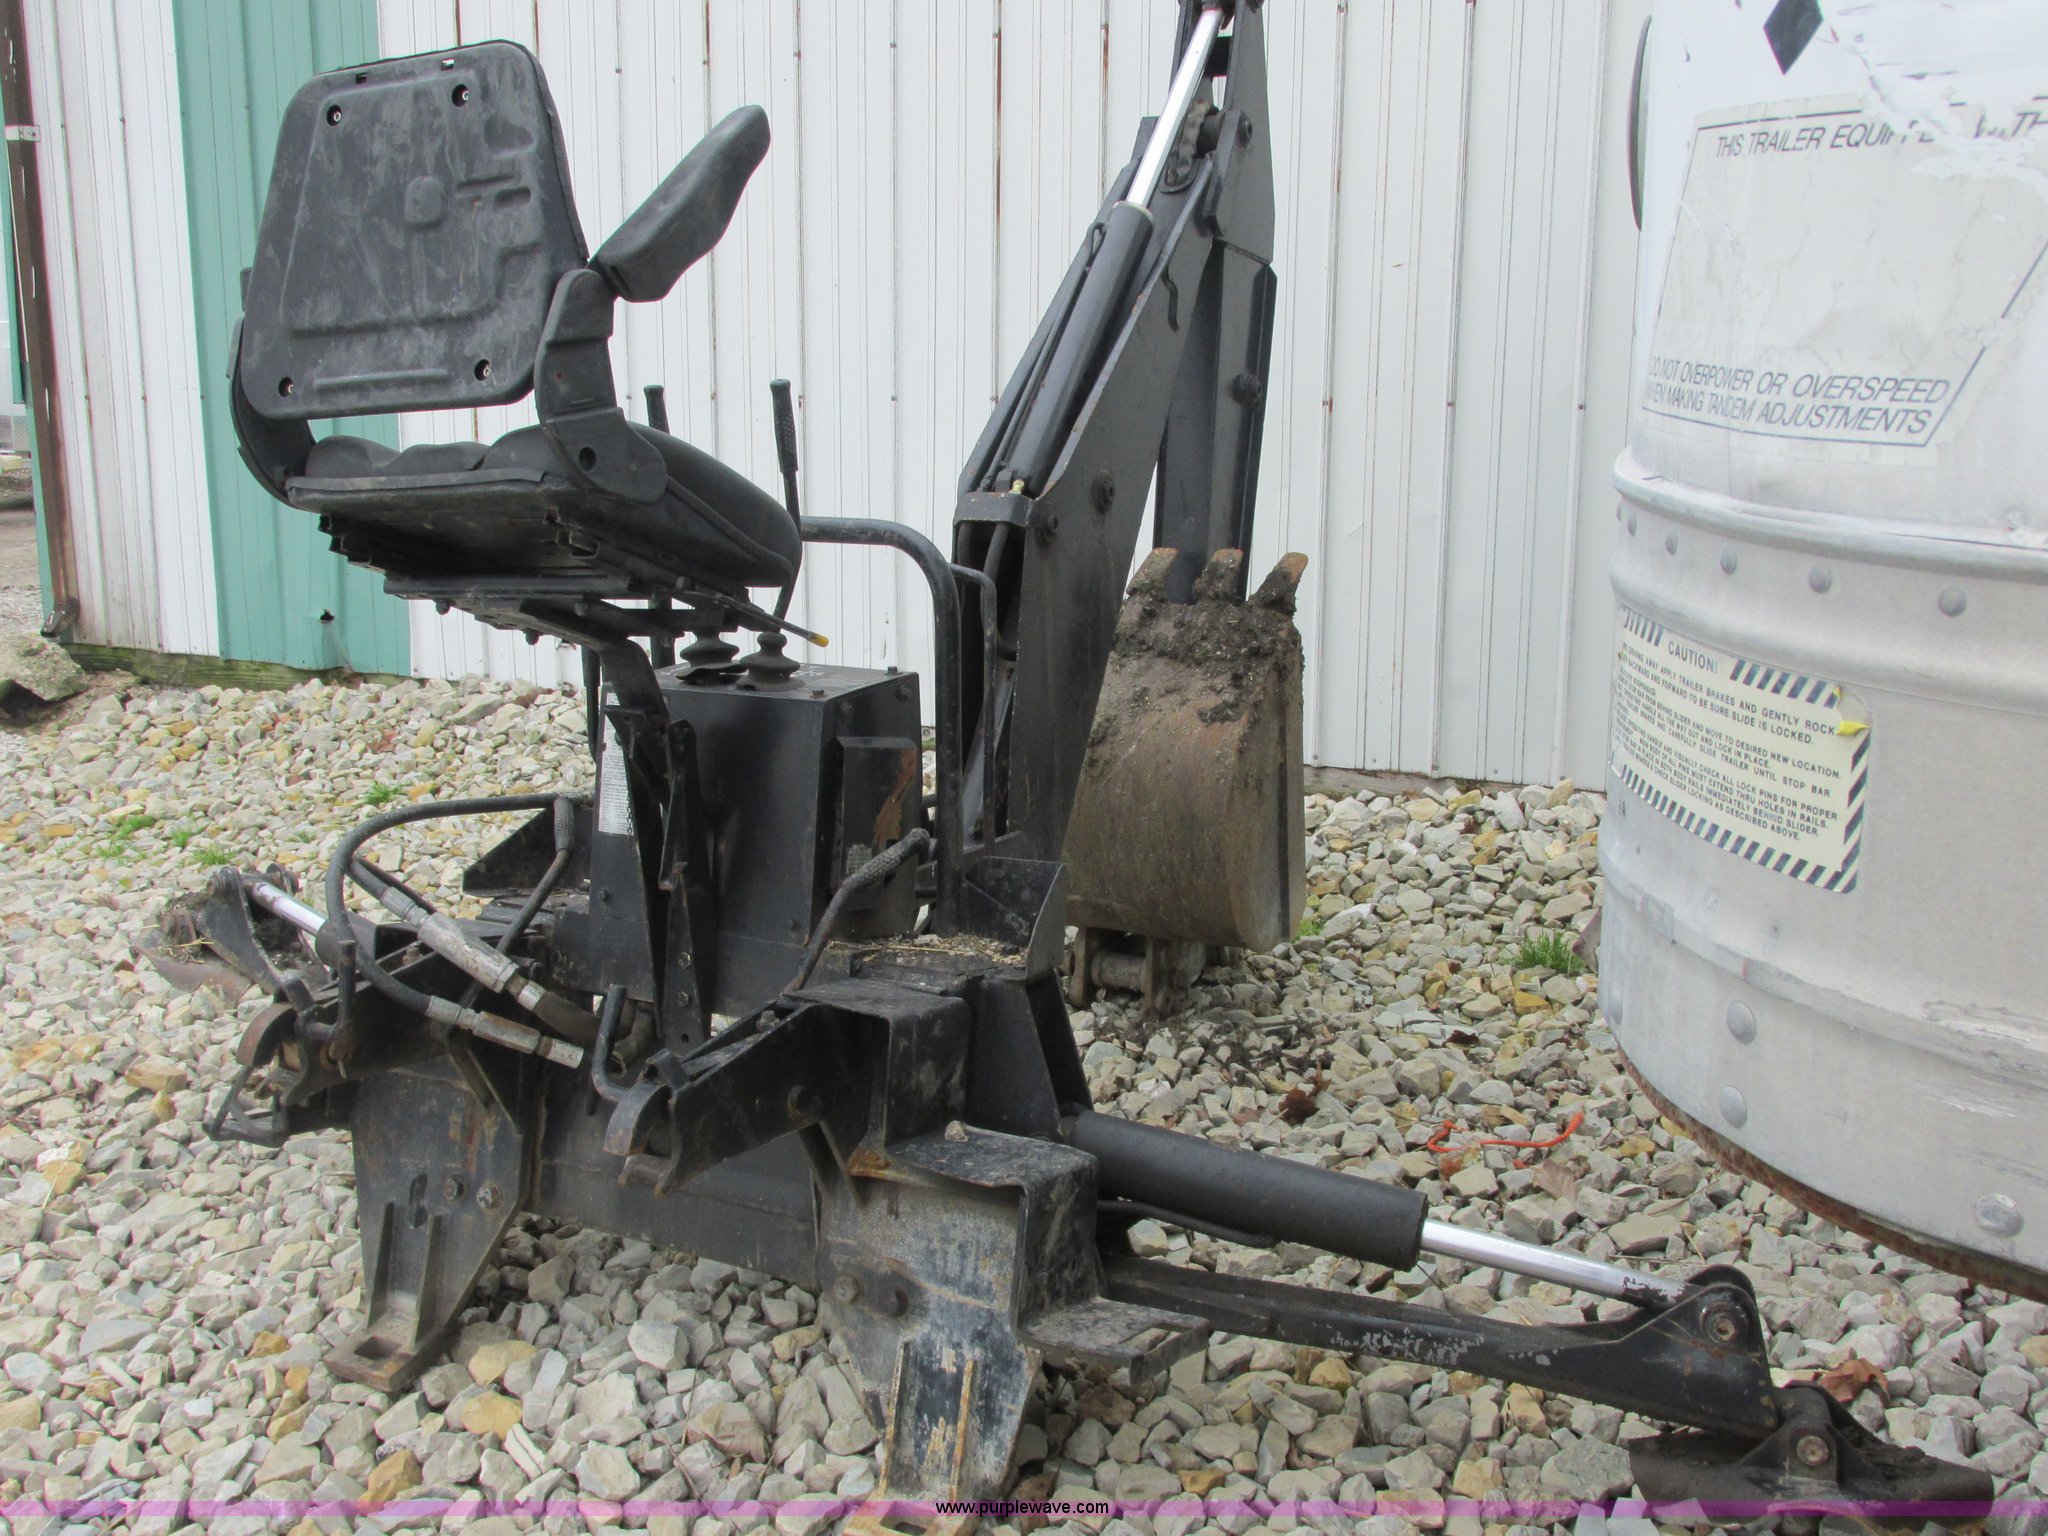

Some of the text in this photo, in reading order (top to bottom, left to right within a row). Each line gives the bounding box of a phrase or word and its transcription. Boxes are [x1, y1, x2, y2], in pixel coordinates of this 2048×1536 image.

[1716, 134, 1744, 158] THIS
[1748, 127, 1827, 155] TRAILER
[1660, 358, 1681, 381] NOT
[1680, 361, 1755, 393] OVERPOWER
[1757, 371, 1788, 397] OR
[1793, 373, 1951, 404] OVERSPEED
[1667, 386, 1705, 412] MAKING
[1707, 392, 1756, 422] TANDEM
[1757, 402, 1933, 435] ADJUSTMENTS
[1668, 640, 1718, 674] CAUTION!
[1650, 673, 1661, 685] AND
[1661, 679, 1688, 700] FORWARD
[1689, 693, 1698, 704] TO
[1699, 698, 1708, 709] BE
[1710, 702, 1729, 718] SURE
[1732, 711, 1756, 728] SLIDE
[1758, 720, 1767, 731] IS
[1770, 726, 1814, 745] LOCKED.
[1660, 666, 1677, 680] APPLY
[1679, 674, 1703, 694] TRAILER
[1706, 687, 1736, 707] BRAKES
[1739, 700, 1757, 714] AND
[1762, 707, 1800, 727] GENTLY
[1805, 719, 1836, 737] ROCK
[1668, 727, 1697, 748] CAREFULLY
[1699, 744, 1717, 759] SLIDE
[1720, 753, 1749, 771] TRAILER
[1753, 767, 1777, 782] UNTIL
[1782, 775, 1806, 790] STOP
[1811, 784, 1831, 798] BAR
[1674, 711, 1691, 726] SLIDER
[1692, 721, 1704, 733] AND
[1705, 727, 1723, 741] MOVE
[1725, 734, 1734, 746] TO
[1736, 737, 1769, 758] DESIRED
[1770, 750, 1790, 765] NEW
[1792, 756, 1842, 780] LOCATION.
[1688, 728, 1699, 739] OUT
[1701, 735, 1713, 747] AND
[1714, 741, 1733, 756] LOCK
[1734, 748, 1742, 759] IN
[1744, 752, 1772, 769] PLACE.
[1673, 769, 1687, 782] BODY
[1688, 776, 1704, 792] RAILS
[1705, 784, 1751, 812] IMMEDIATELY
[1753, 807, 1783, 825] BEHIND
[1786, 818, 1820, 837] SLIDER.
[1674, 750, 1698, 769] VISUALLY
[1699, 762, 1720, 779] CHECK
[1722, 773, 1734, 787] ALL
[1736, 779, 1757, 794] LOCK
[1759, 788, 1778, 803] PINS
[1781, 796, 1798, 810] FOR
[1800, 802, 1838, 821] PROPER
[1678, 762, 1690, 775] PINS
[1690, 768, 1707, 783] MUST
[1708, 776, 1734, 796] EXTEND
[1736, 790, 1756, 805] THRU
[1758, 799, 1785, 815] HOLES
[1787, 808, 1797, 819] IN
[1800, 812, 1829, 829] RAILS.
[1688, 788, 1713, 807] LOCKING
[1714, 801, 1724, 812] AS
[1725, 806, 1768, 829] DESCRIBED
